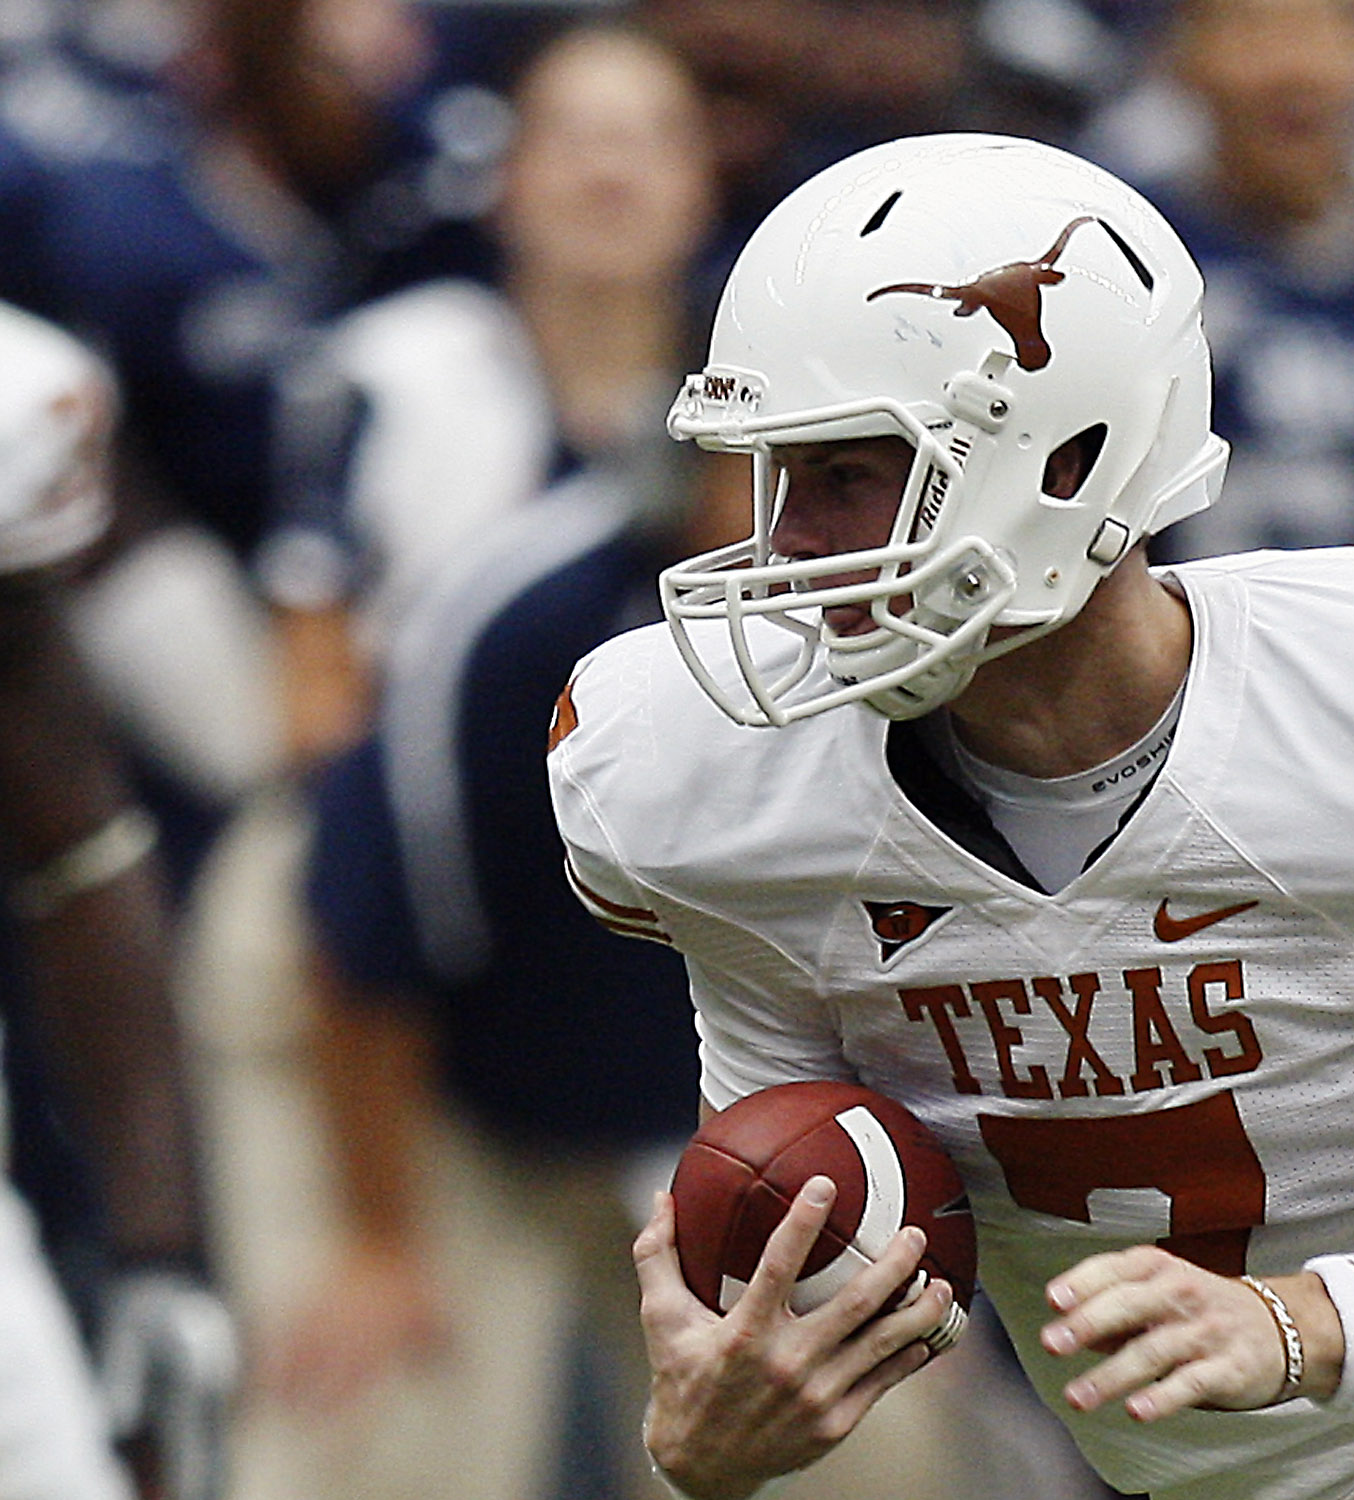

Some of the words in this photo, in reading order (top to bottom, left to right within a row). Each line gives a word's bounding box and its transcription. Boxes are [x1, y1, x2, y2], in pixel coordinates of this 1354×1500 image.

[920, 437, 971, 531] Riddll
[898, 960, 1263, 1098] TEXAS
[977, 1089, 1267, 1277] 7
